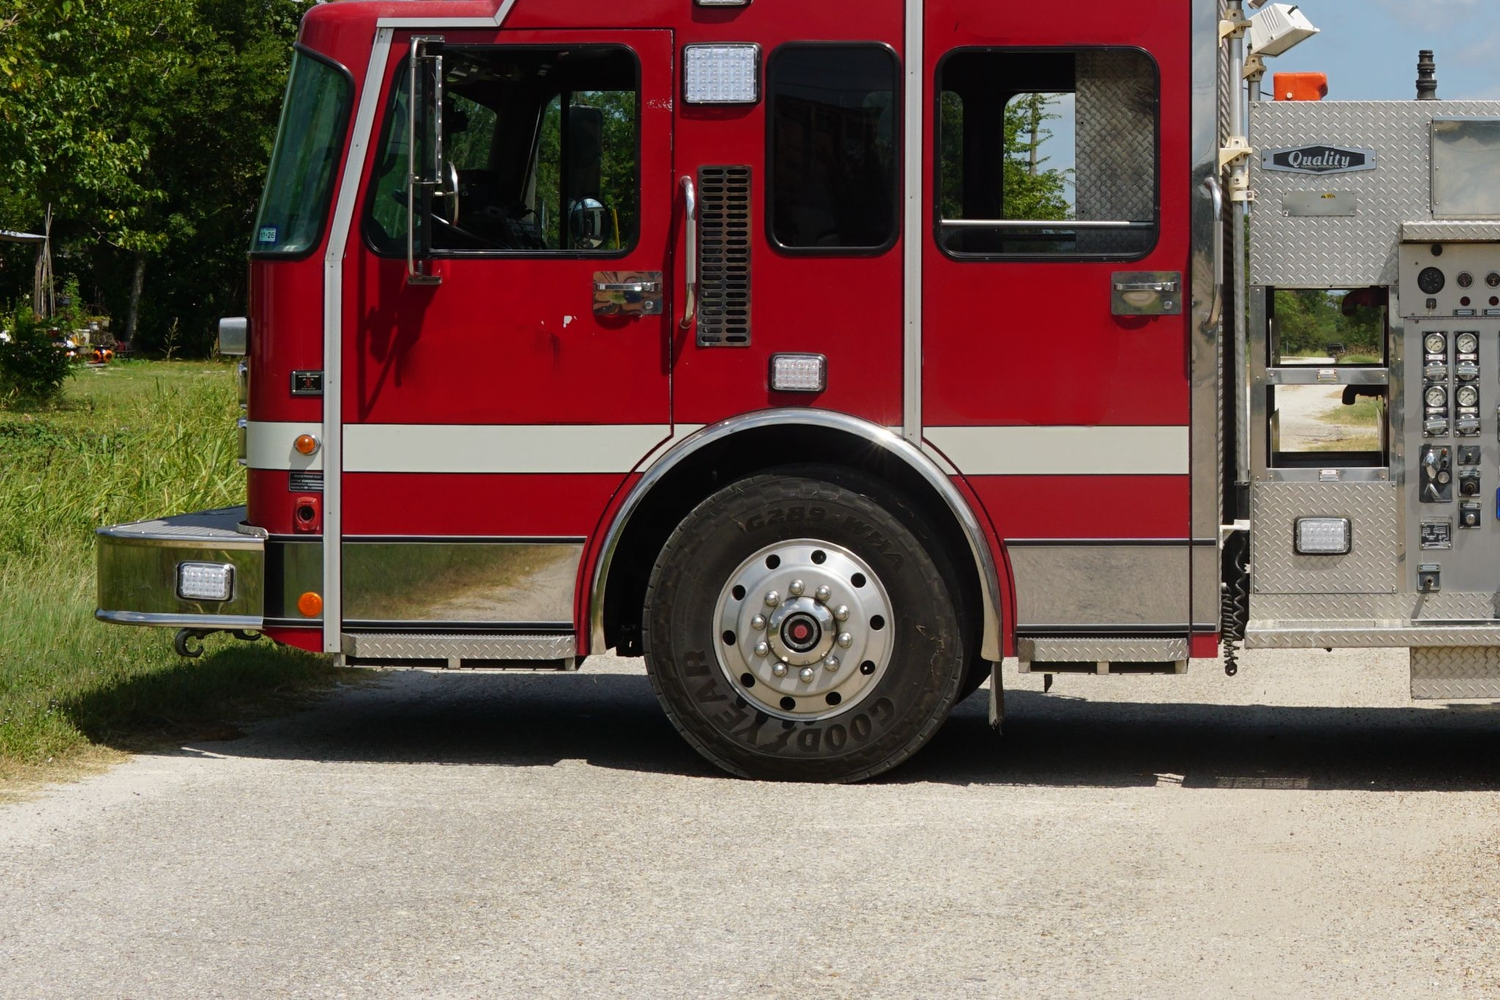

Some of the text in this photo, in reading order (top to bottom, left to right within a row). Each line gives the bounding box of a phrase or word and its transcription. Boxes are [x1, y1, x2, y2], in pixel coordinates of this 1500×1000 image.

[1288, 150, 1350, 168] Quality
[744, 506, 827, 532] G289
[683, 650, 897, 752] GOODYEAR
